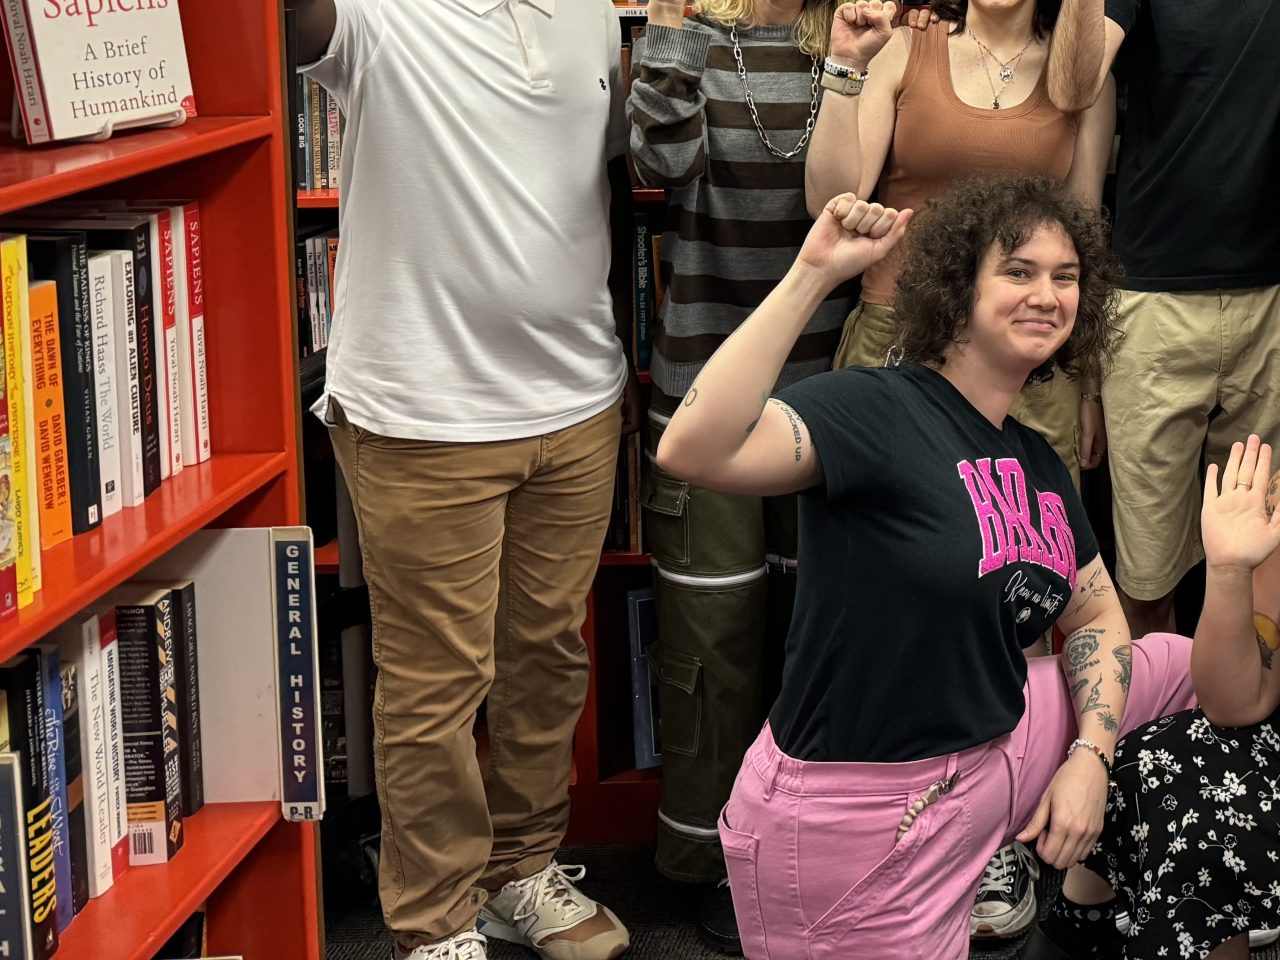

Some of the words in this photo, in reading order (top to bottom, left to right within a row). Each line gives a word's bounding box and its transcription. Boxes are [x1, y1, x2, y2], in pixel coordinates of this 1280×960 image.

[15, 30, 32, 66] Noah
[84, 42, 99, 62] A
[103, 36, 148, 60] Brief
[23, 64, 39, 107] Harari
[72, 66, 143, 92] History
[148, 60, 167, 81] of
[70, 85, 179, 120] Humankind
[297, 113, 305, 134] LOOK
[298, 134, 306, 149] BIG
[328, 140, 337, 171] PELTON
[163, 229, 176, 318] SAPIENS
[188, 220, 204, 306] SAPIENS
[94, 274, 108, 330] Richard
[124, 260, 136, 327] EXPLORING
[44, 311, 55, 335] THE
[127, 330, 136, 344] an
[139, 304, 152, 370] Homo
[196, 325, 206, 358] Yuval
[31, 318, 47, 390] EVERYTHING
[46, 338, 57, 370] DAWN
[97, 332, 109, 375] Haass
[128, 347, 138, 382] ALIEN
[169, 337, 178, 370] Yuval
[49, 372, 59, 388] OF
[99, 377, 111, 402] The
[171, 371, 180, 404] Noah
[198, 359, 208, 390] Noah
[130, 383, 141, 436] CULTURE
[142, 374, 154, 426] Deus
[200, 392, 210, 431] Harari
[38, 419, 50, 455] DAVID
[51, 413, 62, 449] DAVID
[101, 404, 113, 452] World
[173, 406, 182, 445] Harari
[42, 455, 55, 511] WENGROW
[55, 449, 67, 501] GRAEBER
[285, 544, 303, 656] GENERAL
[1003, 569, 1035, 604] Know
[1031, 592, 1042, 604] no
[1040, 584, 1064, 619] limits
[159, 599, 174, 665] ANDREW
[90, 671, 100, 703] The
[91, 704, 102, 742] New
[160, 690, 172, 758] MUELLER
[290, 674, 309, 784] HISTORY
[94, 743, 106, 791] World
[97, 794, 109, 847] Reader
[26, 798, 58, 925] LEADERS
